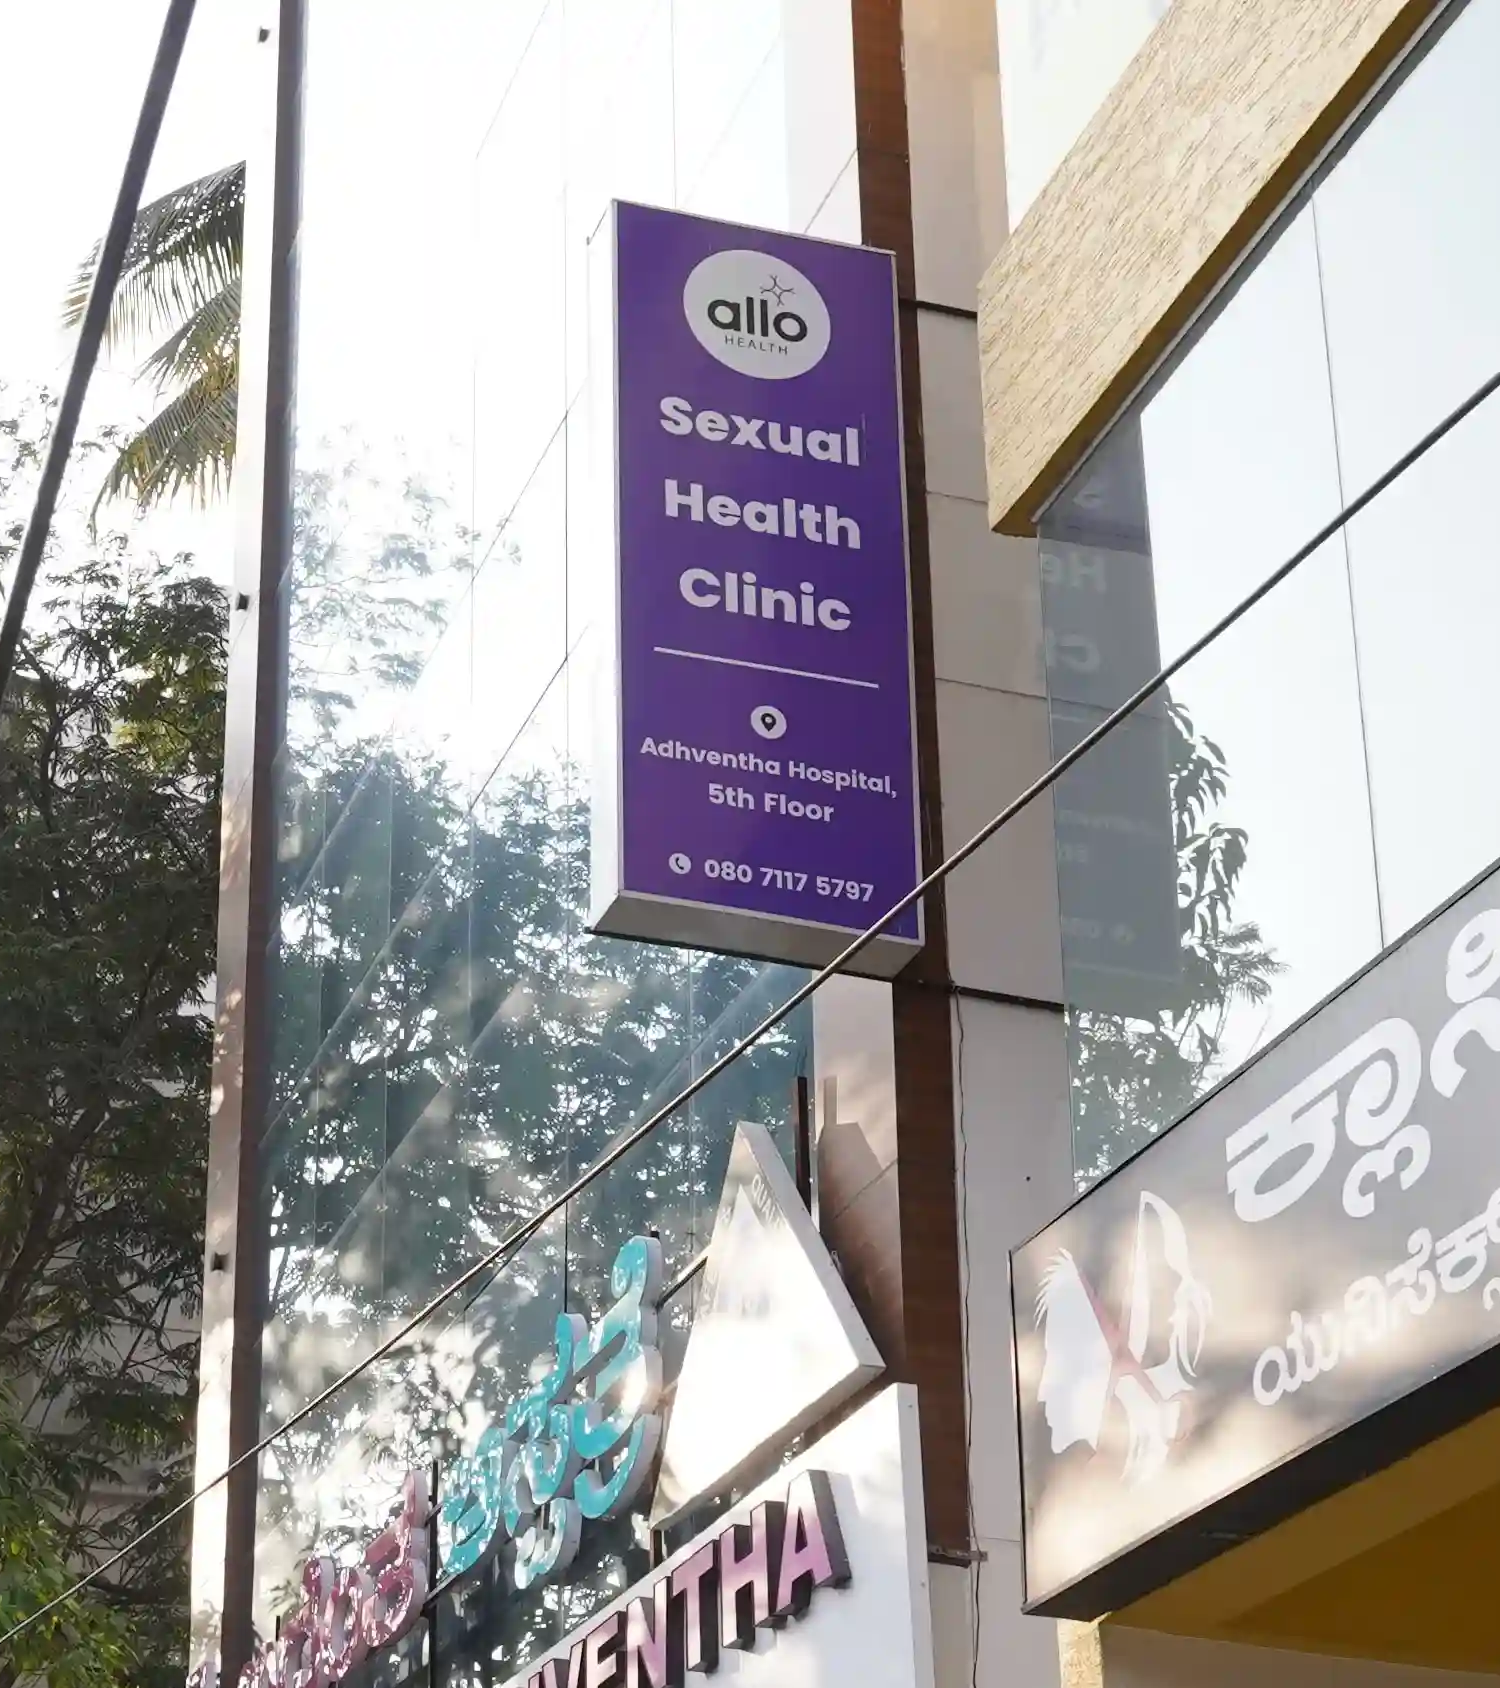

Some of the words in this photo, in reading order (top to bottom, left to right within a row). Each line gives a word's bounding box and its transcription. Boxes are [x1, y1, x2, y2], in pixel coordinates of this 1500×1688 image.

[707, 298, 808, 343] allo
[724, 335, 789, 355] HEALTH
[659, 396, 860, 466] Sexual
[664, 478, 861, 549] Health
[679, 568, 851, 631] Clinic
[640, 737, 781, 776] Adhventha
[788, 760, 898, 799] Hospital,
[708, 782, 755, 811] 5th
[764, 792, 835, 822] Floor
[704, 858, 753, 883] 080
[759, 867, 808, 892] 7117
[815, 875, 875, 902] 5797
